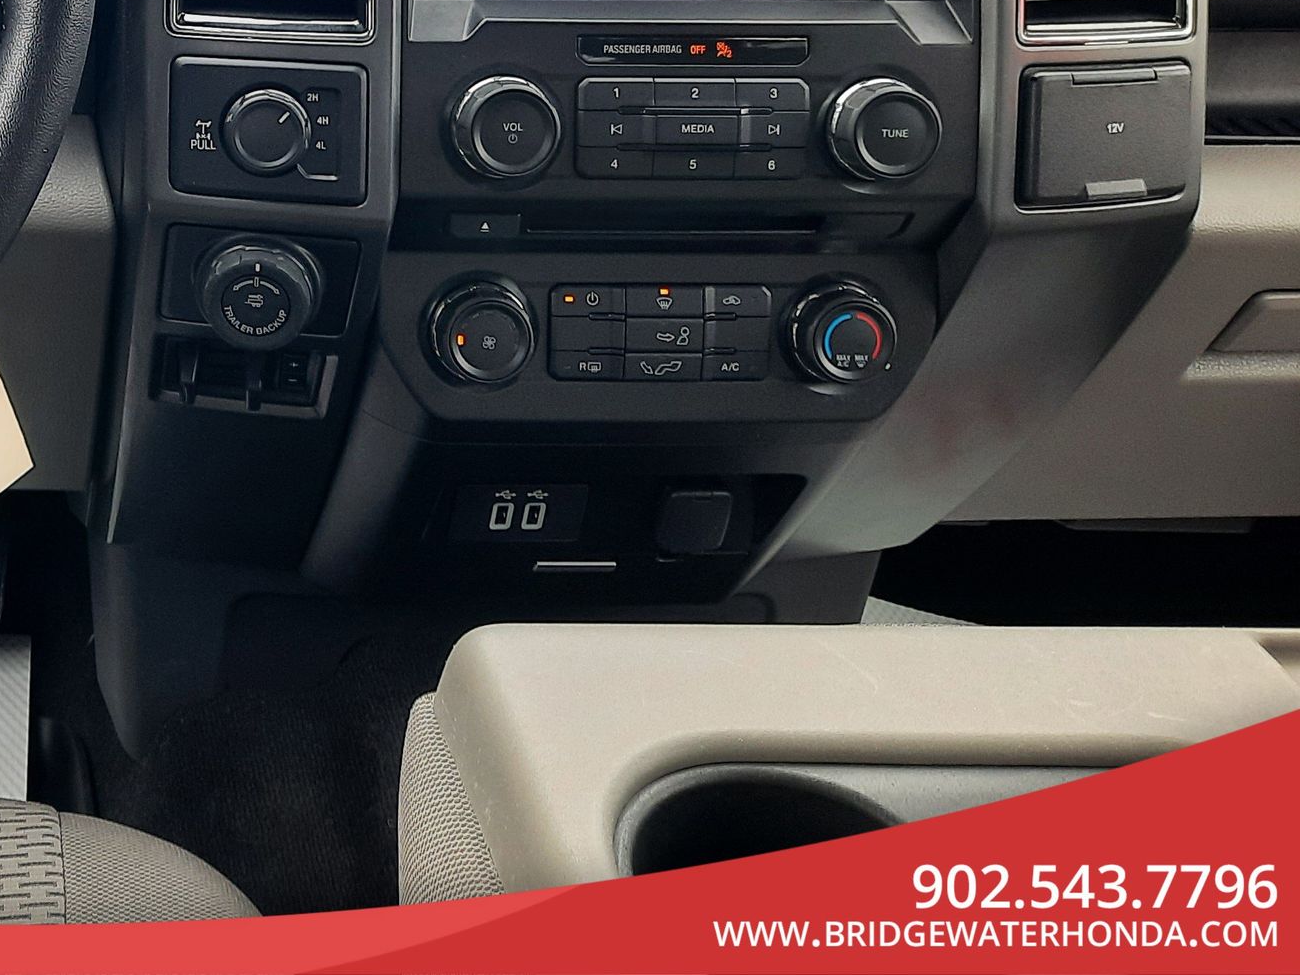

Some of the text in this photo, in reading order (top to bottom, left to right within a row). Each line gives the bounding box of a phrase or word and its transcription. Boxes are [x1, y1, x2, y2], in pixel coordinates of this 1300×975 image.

[603, 44, 707, 55] PASSENGER AIRBAG OFF
[306, 93, 320, 103] 2H
[612, 87, 620, 99] 1
[690, 87, 700, 99] 2
[769, 87, 779, 99] 3
[316, 116, 330, 126] 4H
[503, 121, 524, 133] VOL
[681, 123, 715, 134] MEDIA
[881, 128, 910, 139] TUNE
[1106, 122, 1125, 134] 12V
[190, 139, 216, 151] PULL
[315, 139, 327, 150] 4L
[610, 159, 619, 170] 4
[688, 158, 698, 170] 5
[767, 159, 776, 171] 6
[223, 304, 287, 335] TRAILER BACKUP
[579, 362, 588, 372] R
[720, 361, 741, 373] A/C
